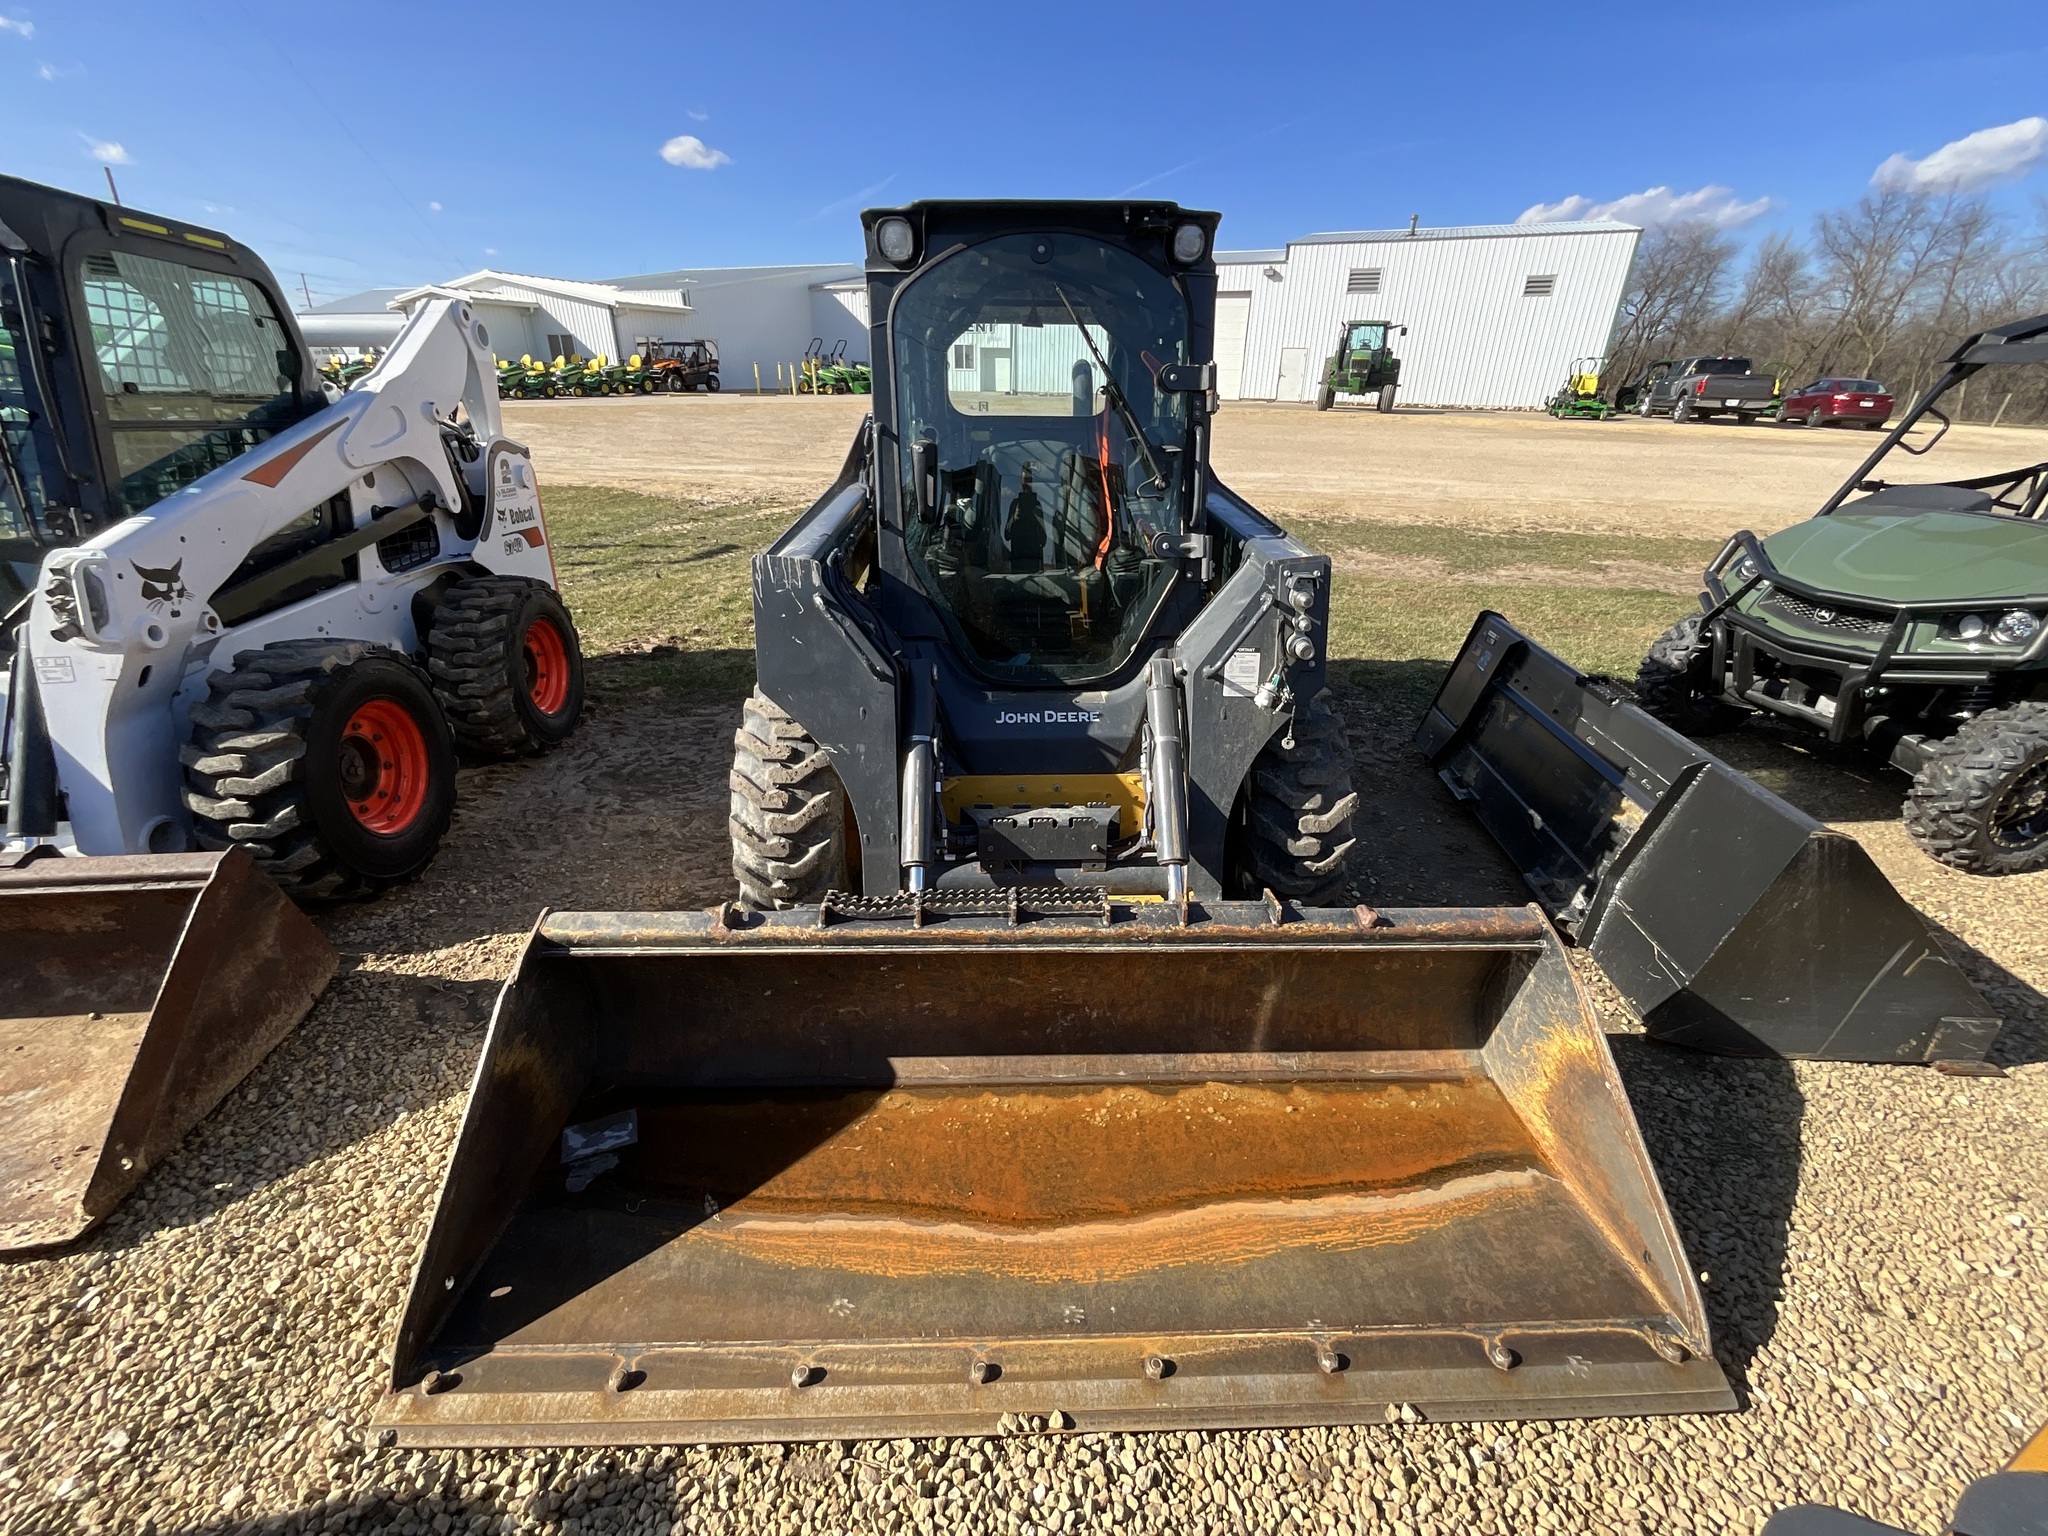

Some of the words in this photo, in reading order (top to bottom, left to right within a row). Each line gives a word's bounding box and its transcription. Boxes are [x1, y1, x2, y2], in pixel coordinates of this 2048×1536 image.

[509, 506, 535, 524] Bobcat
[995, 710, 1041, 724] JOHN
[1044, 710, 1100, 723] DEERE
